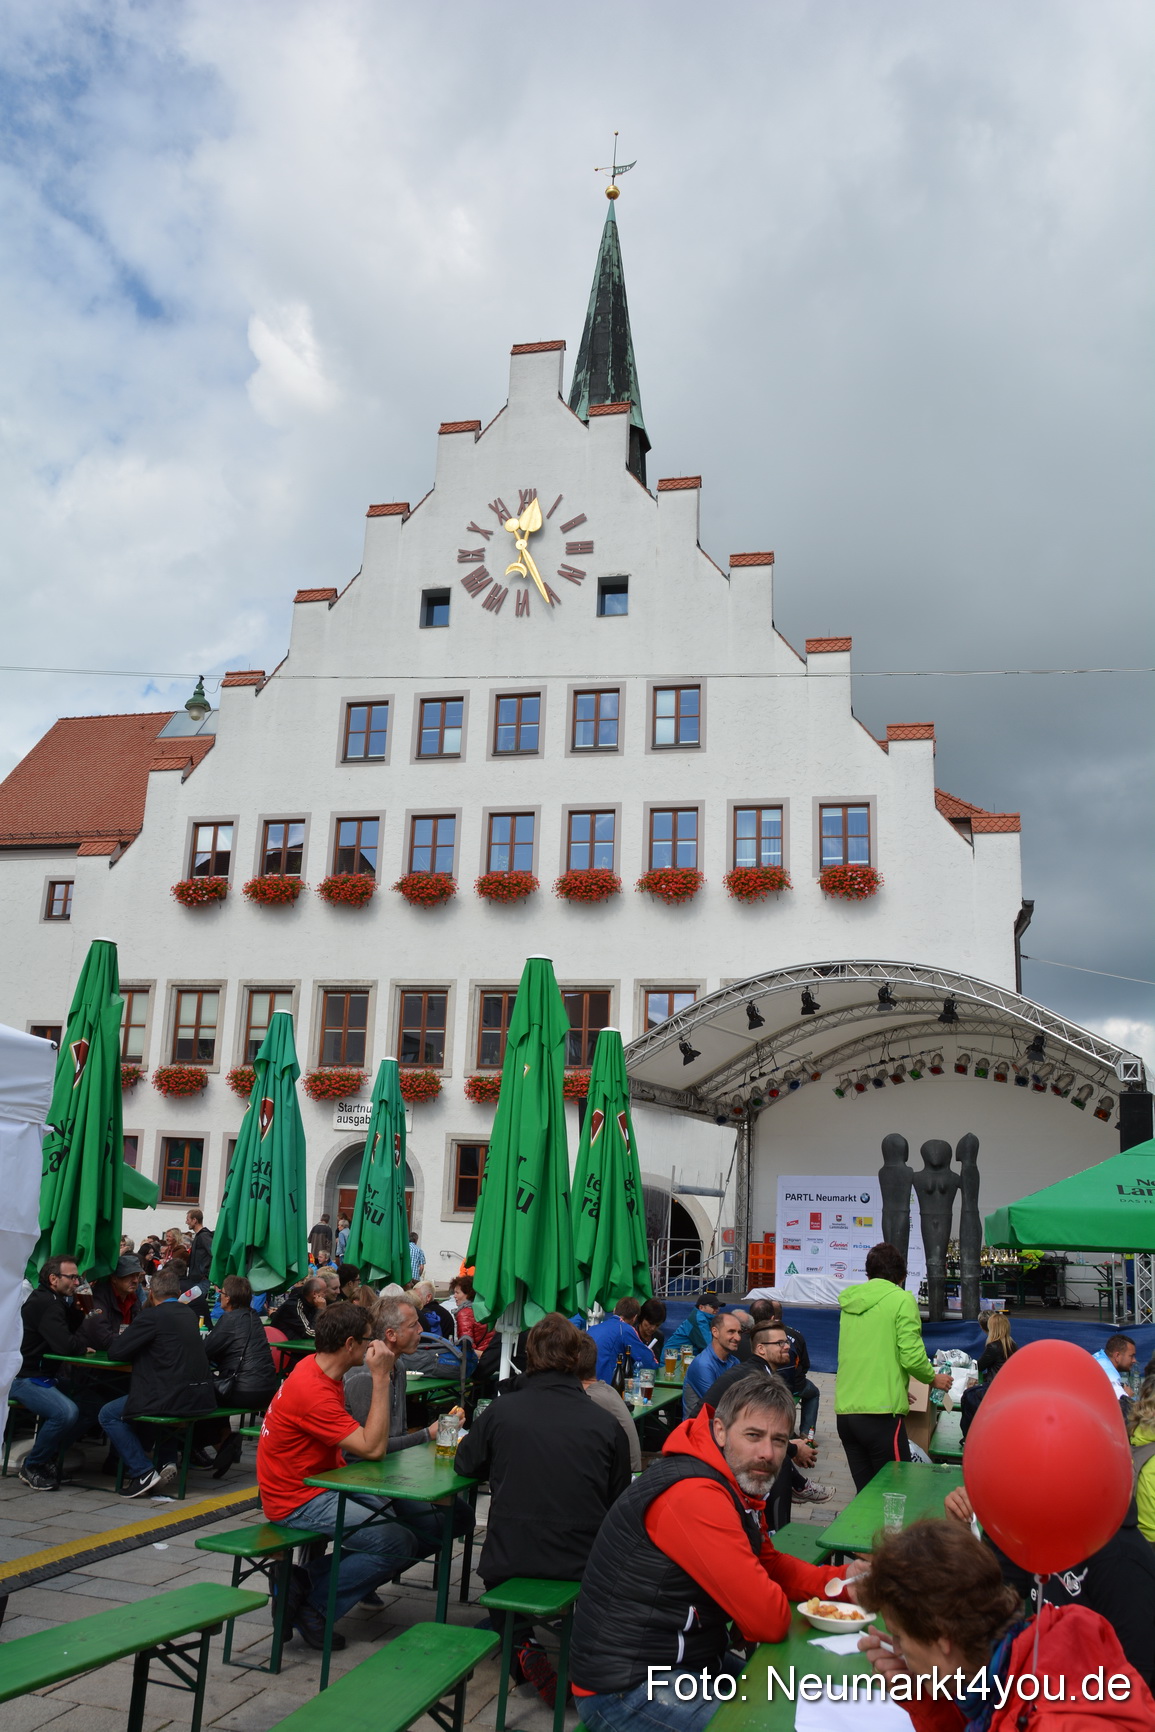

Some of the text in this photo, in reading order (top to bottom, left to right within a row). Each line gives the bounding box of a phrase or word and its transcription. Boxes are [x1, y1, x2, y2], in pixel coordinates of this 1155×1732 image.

[336, 1114, 371, 1127] ausgab
[785, 1193, 857, 1203] PARTL Neumarkt
